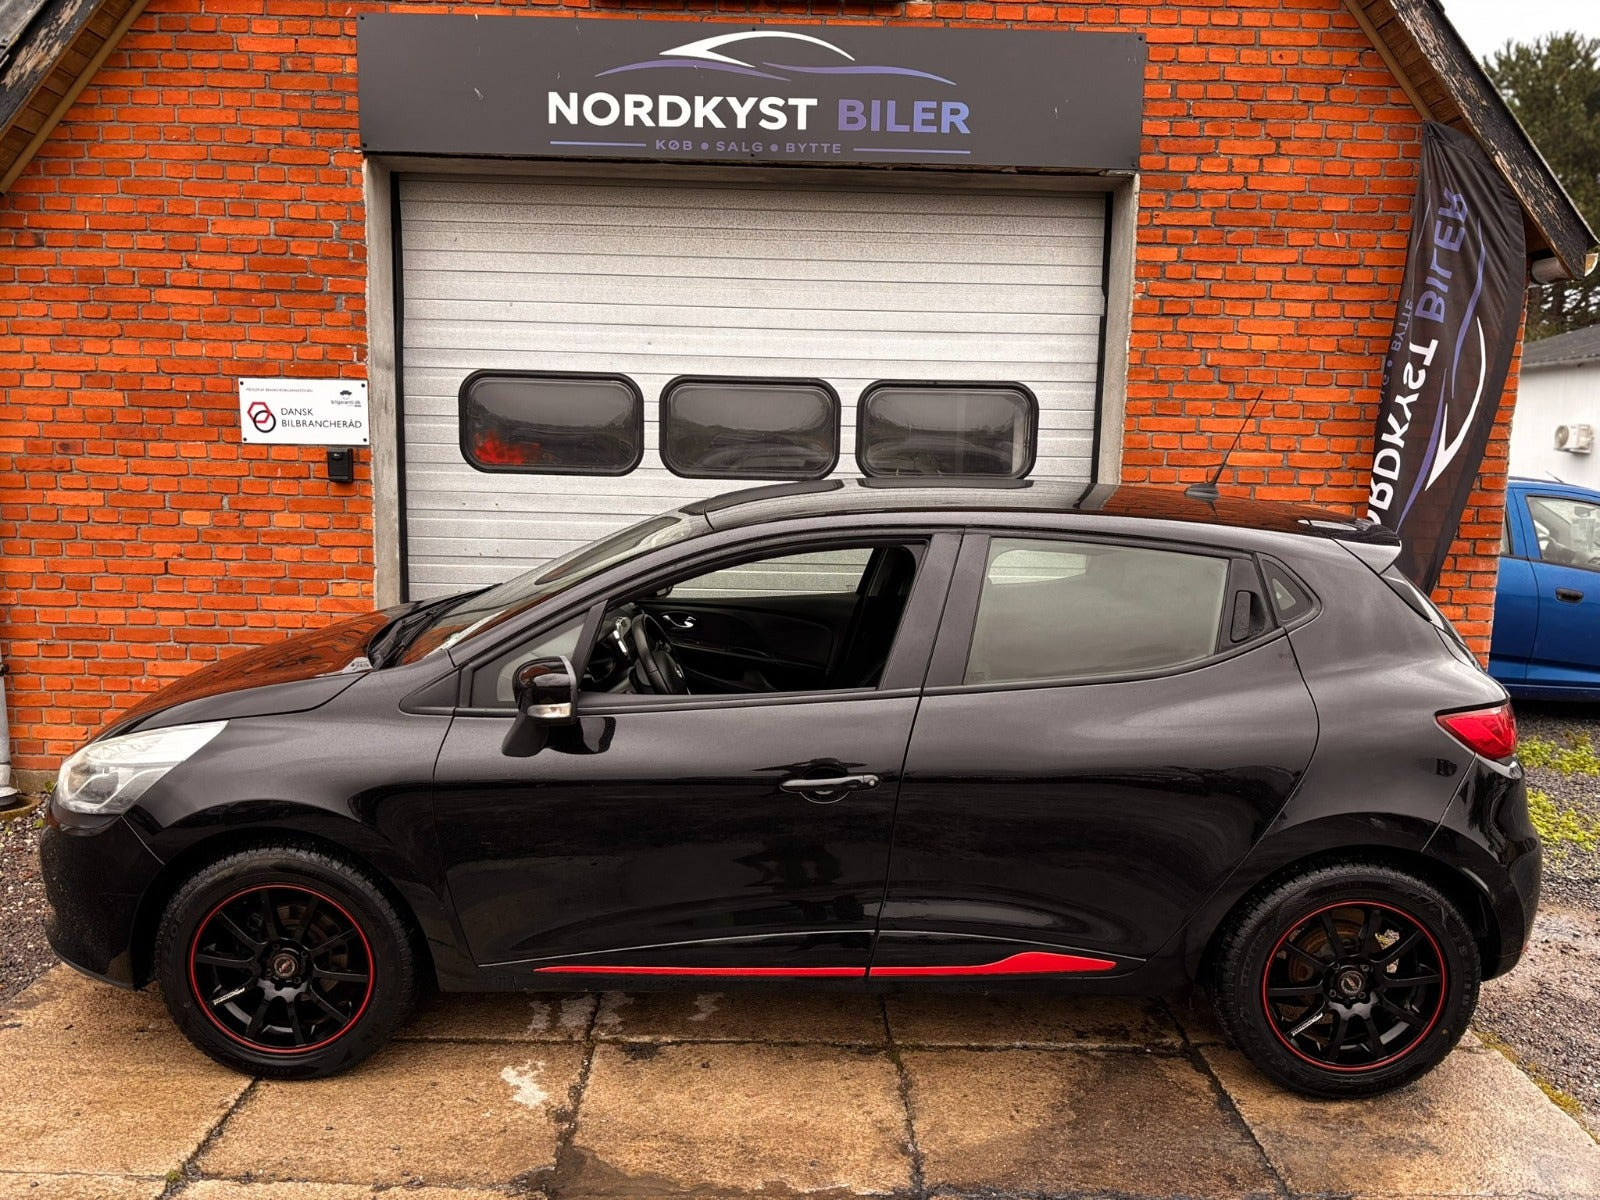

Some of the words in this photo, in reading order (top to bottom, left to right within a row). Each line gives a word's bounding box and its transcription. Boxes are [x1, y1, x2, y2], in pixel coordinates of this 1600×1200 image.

[548, 91, 818, 131] NORDKYST
[838, 99, 971, 134] BILER
[656, 139, 693, 151] KØB
[716, 141, 764, 153] SALG
[785, 142, 841, 154] BYTTE
[280, 407, 314, 417] DANSK
[281, 418, 363, 430] BILBRANCHERÅD
